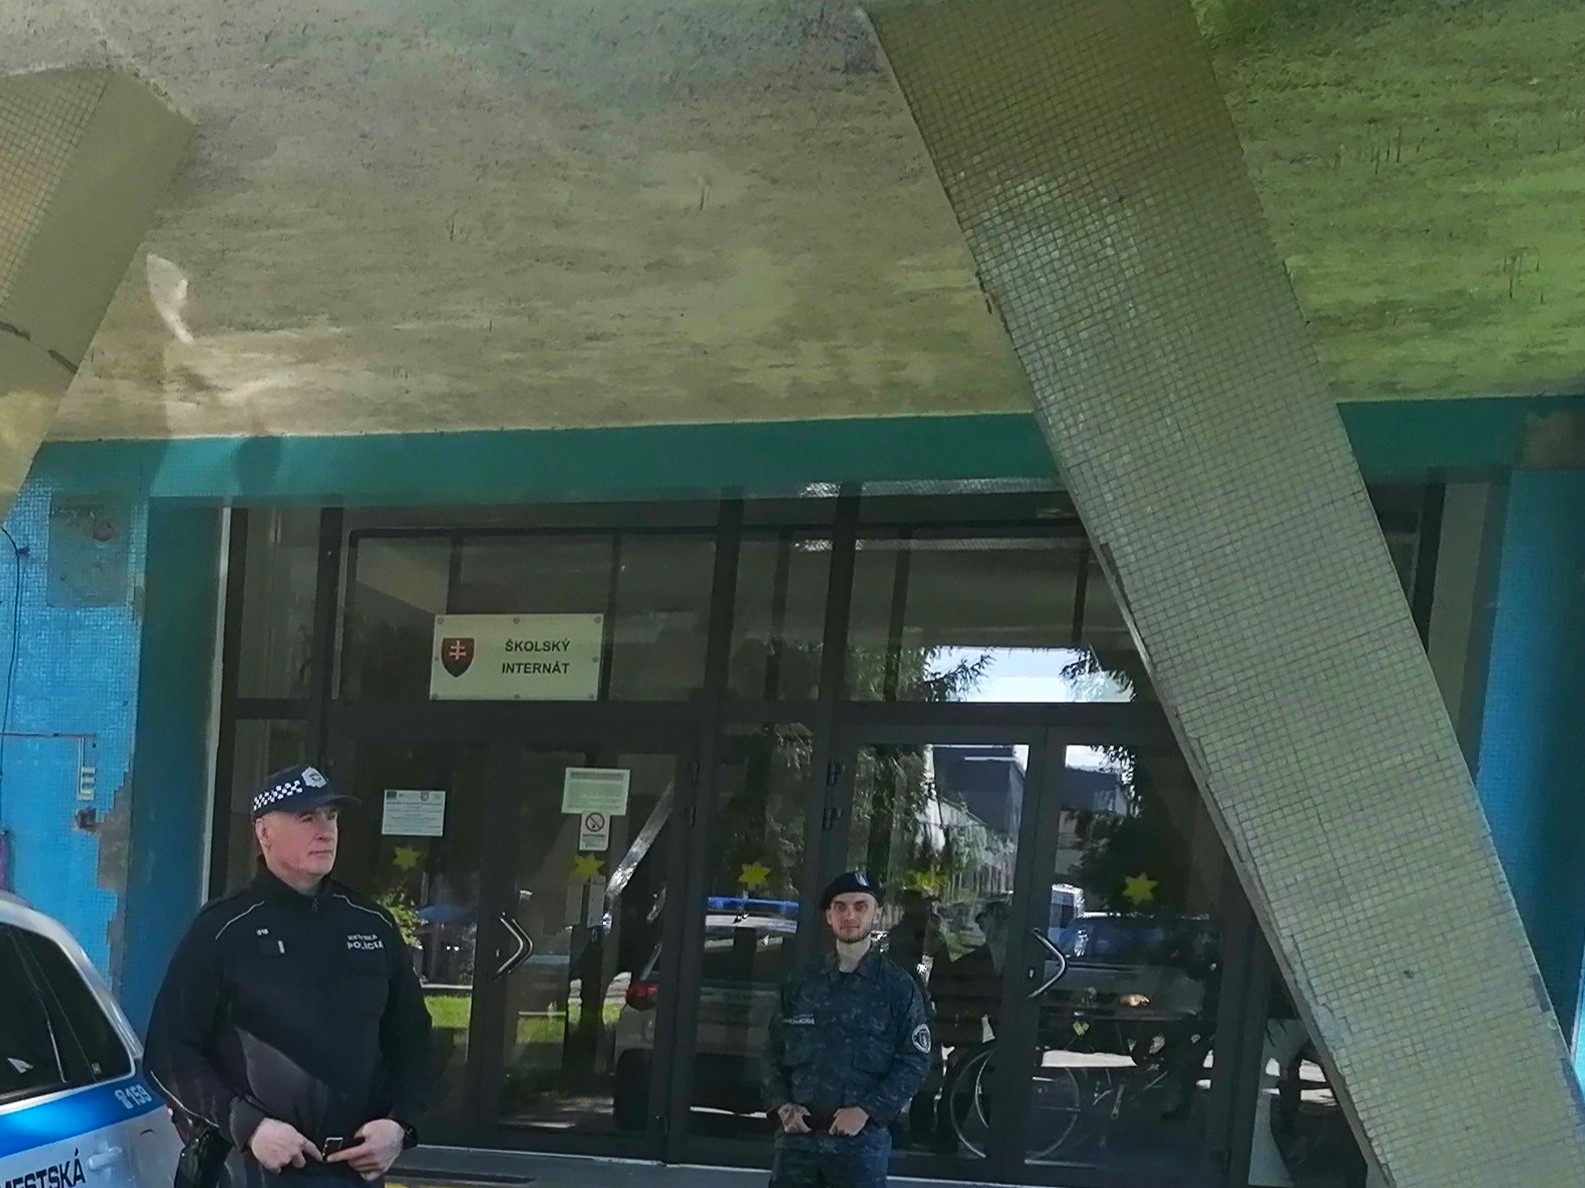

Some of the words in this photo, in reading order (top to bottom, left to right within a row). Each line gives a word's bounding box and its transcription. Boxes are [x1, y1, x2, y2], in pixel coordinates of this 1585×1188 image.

[505, 638, 571, 652] ŠKOLSKÝ
[502, 661, 571, 674] INTERNÁT
[125, 1084, 152, 1105] 159
